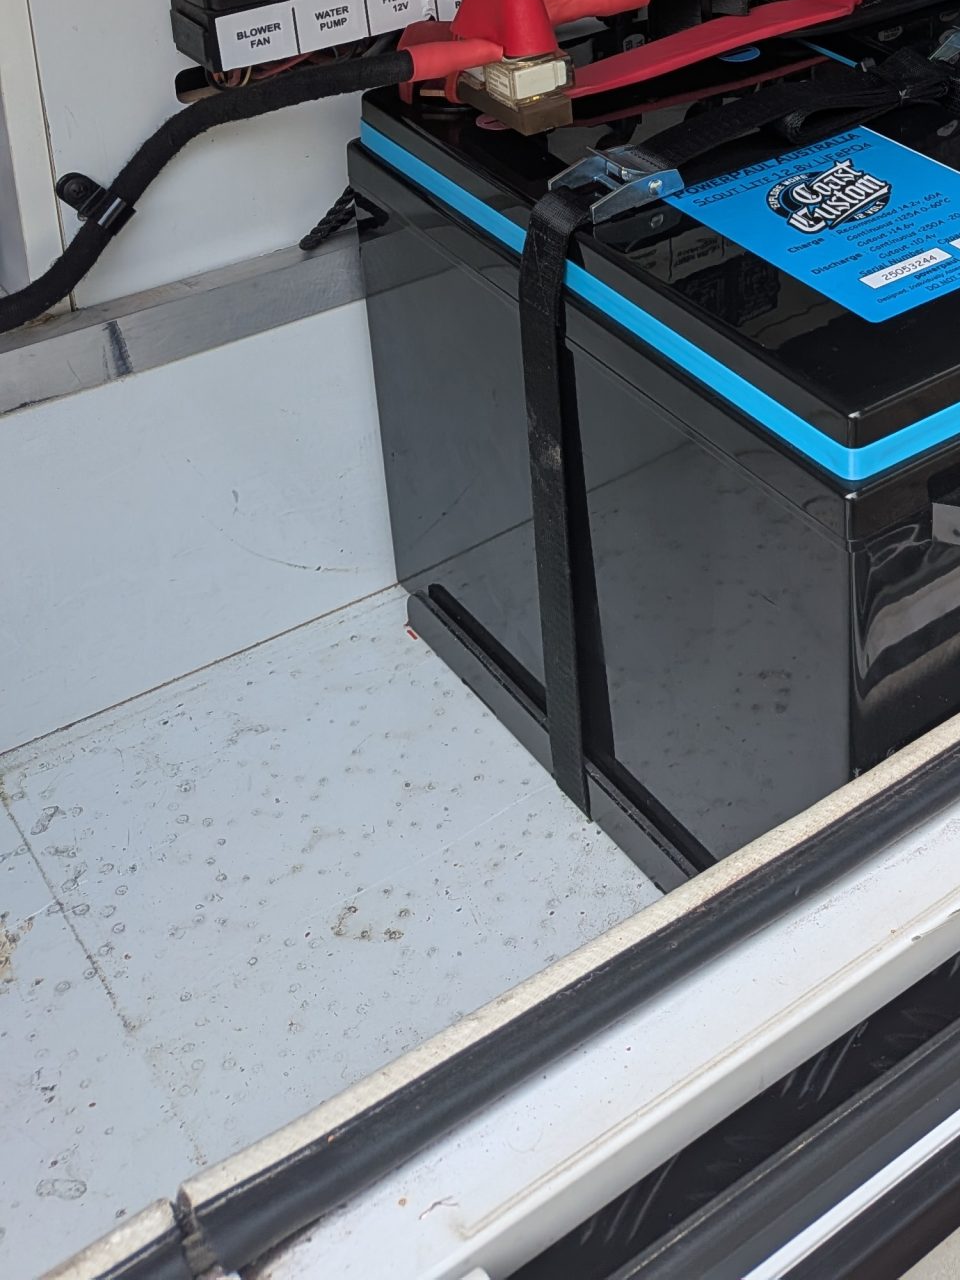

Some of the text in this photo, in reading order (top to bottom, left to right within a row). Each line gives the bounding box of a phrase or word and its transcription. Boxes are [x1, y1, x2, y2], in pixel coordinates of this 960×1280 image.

[315, 5, 349, 20] WATER
[393, 1, 409, 13] 12V
[236, 22, 281, 40] BLOWER
[320, 17, 347, 31] PUMP
[250, 36, 271, 48] FAN
[794, 159, 865, 204] Coast
[787, 175, 888, 234] Custom
[786, 236, 827, 254] Charge
[834, 207, 900, 236] Recommended
[921, 191, 943, 201] 60A
[844, 220, 896, 242] Continuous
[854, 232, 889, 248] Cutout
[810, 251, 865, 276] Discharge
[866, 230, 919, 253] Continuous
[876, 243, 911, 259] Cutout
[858, 246, 928, 276] Serial Number
[879, 253, 940, 281] 25053244
[925, 283, 942, 291] DO
[939, 275, 960, 285] NOT
